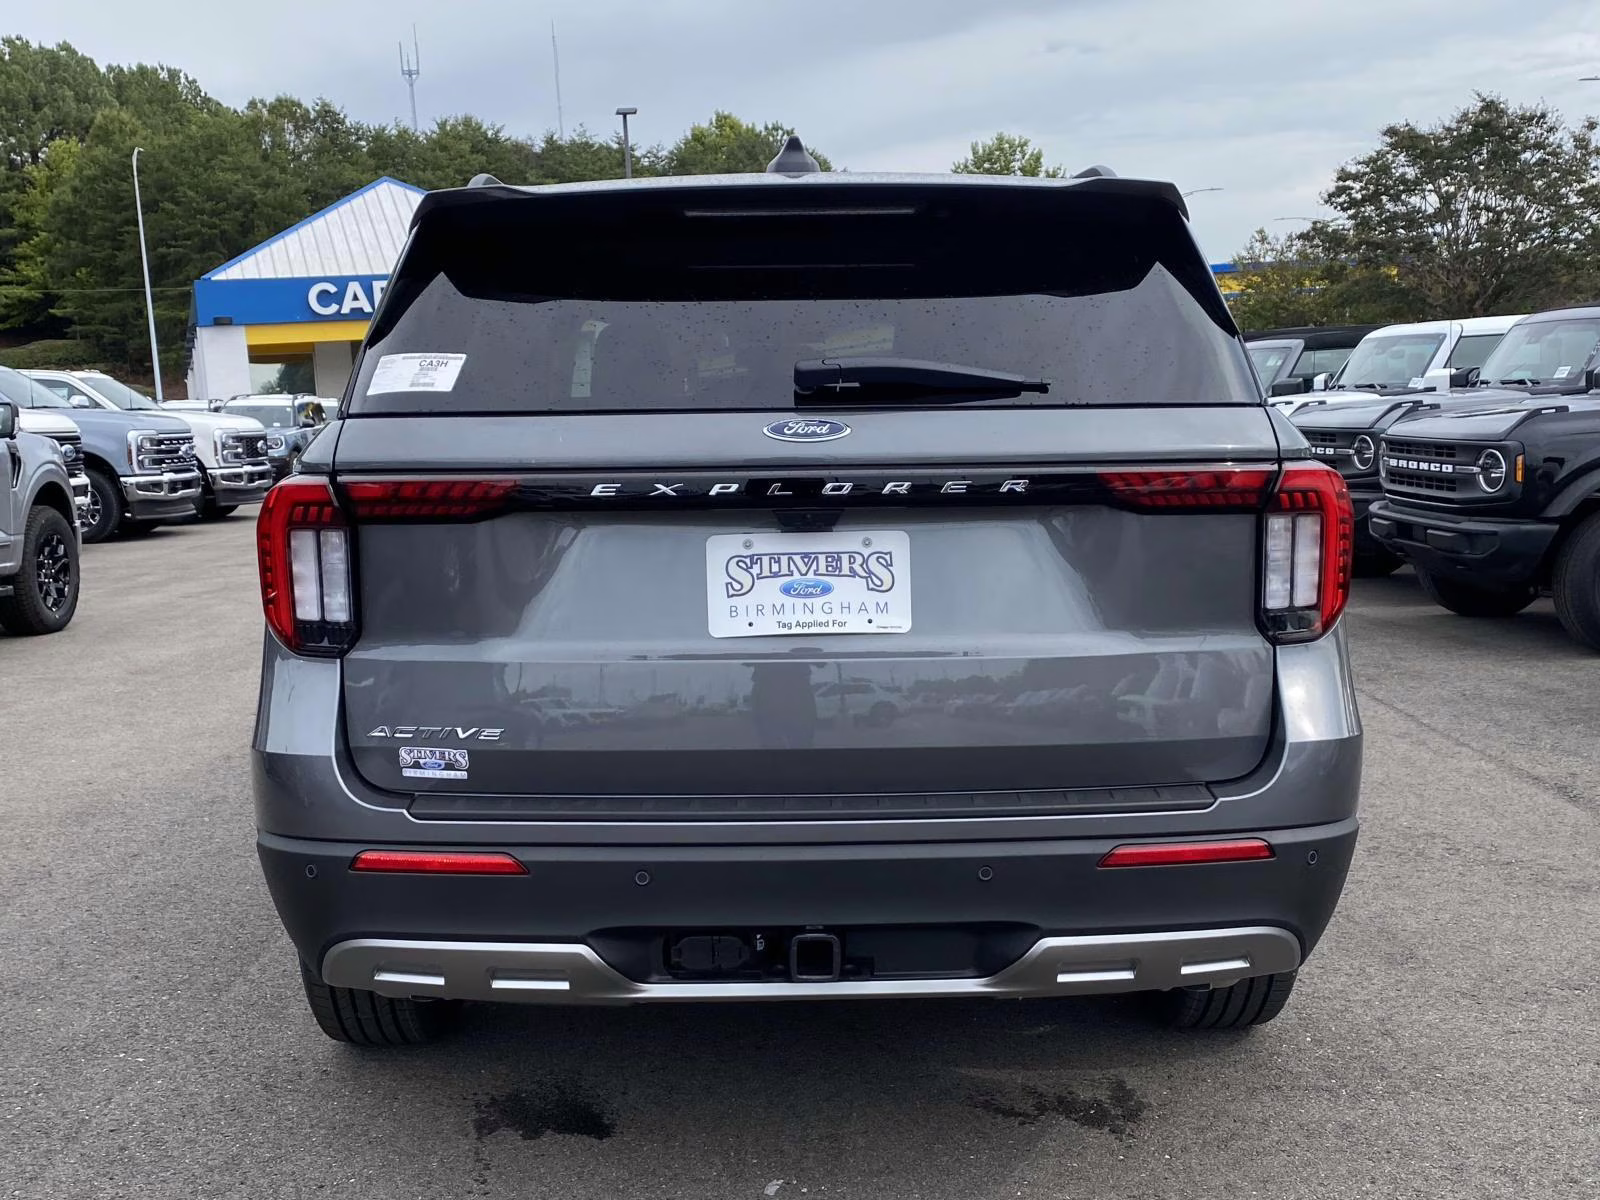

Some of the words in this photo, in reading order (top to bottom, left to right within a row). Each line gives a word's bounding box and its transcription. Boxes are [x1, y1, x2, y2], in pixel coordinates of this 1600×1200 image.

[418, 359, 449, 368] CA3H
[783, 420, 831, 435] Ford
[1389, 458, 1454, 473] BRONCO
[590, 480, 1030, 496] EXPLORER
[725, 550, 896, 599] STIVERS
[789, 581, 824, 595] Ford
[729, 601, 890, 619] BIRMINGHAM
[776, 620, 793, 631] Tag
[795, 619, 831, 630] Applied
[832, 619, 848, 629] For
[366, 725, 505, 740] ACTIVE
[400, 746, 469, 770] STIVERS
